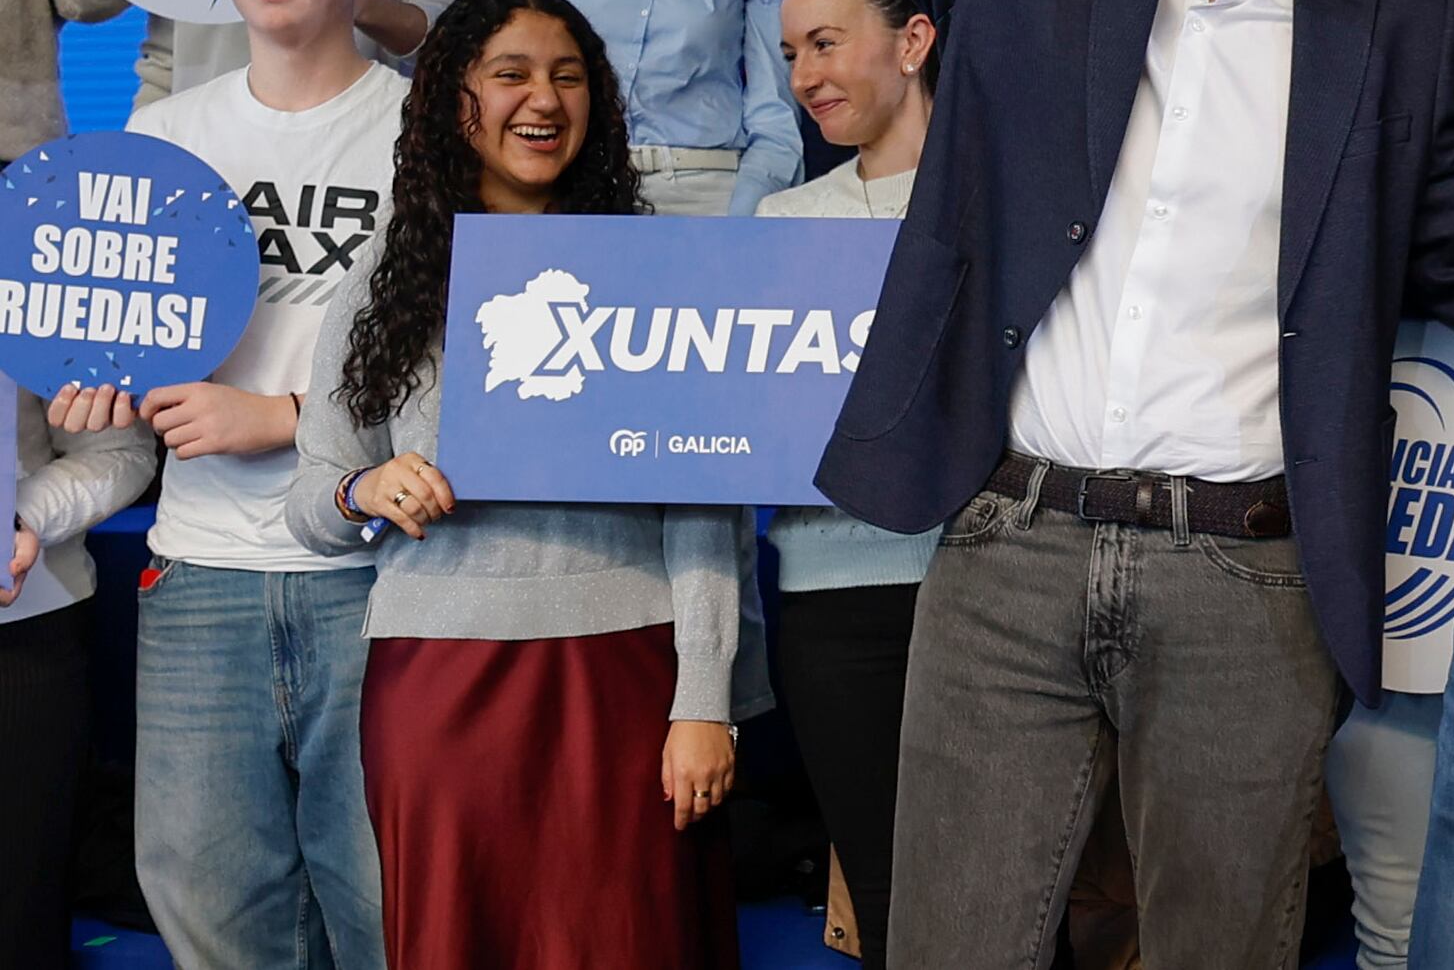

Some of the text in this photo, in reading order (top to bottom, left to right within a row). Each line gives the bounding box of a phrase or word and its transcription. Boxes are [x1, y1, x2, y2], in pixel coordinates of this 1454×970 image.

[78, 172, 152, 225] VAI
[242, 181, 380, 232] AIR
[32, 224, 179, 284] SOBRE
[0, 280, 207, 350] RUEDAS!
[668, 435, 752, 454] GALICIA
